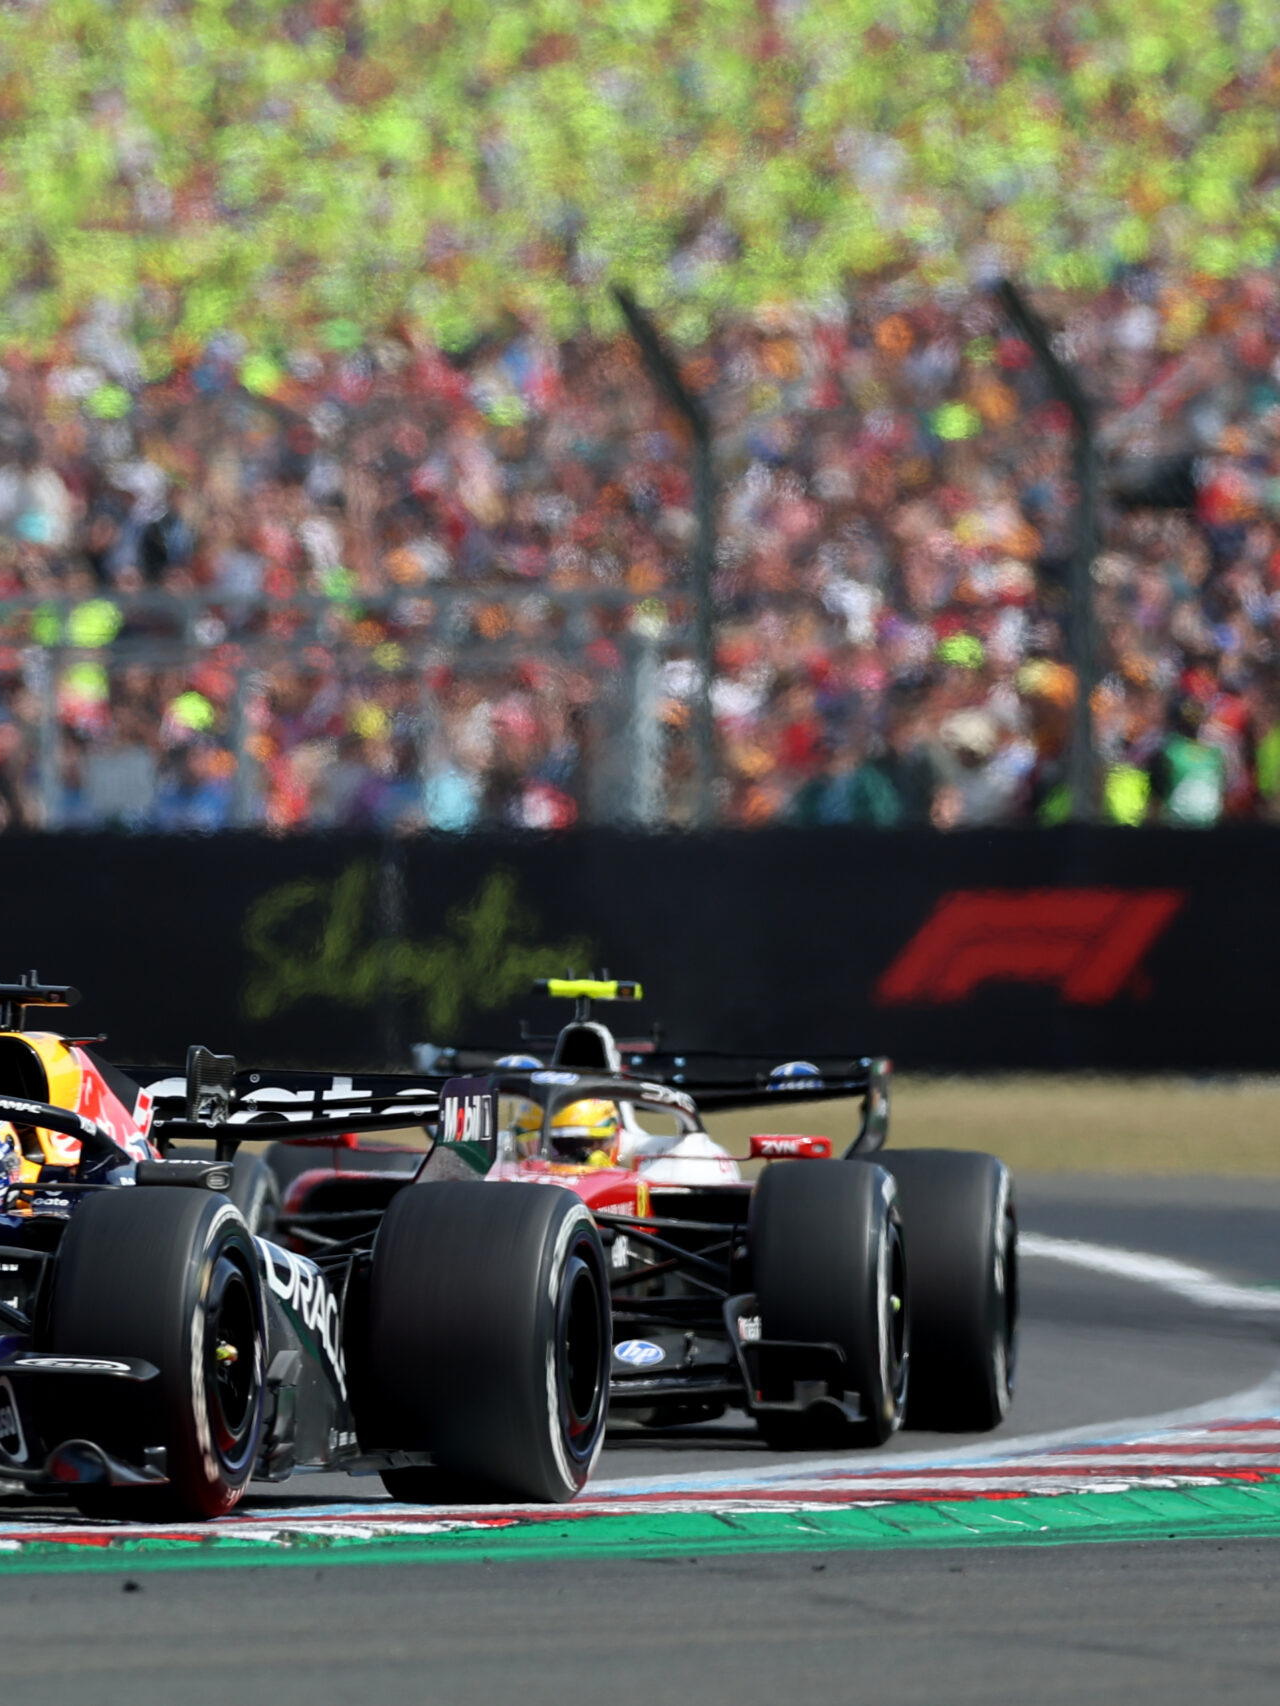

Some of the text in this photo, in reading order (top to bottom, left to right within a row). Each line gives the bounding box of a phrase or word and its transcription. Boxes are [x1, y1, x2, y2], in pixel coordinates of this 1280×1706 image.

[875, 888, 1184, 1004] F1
[444, 1094, 481, 1142] Mobil
[619, 1342, 658, 1365] hp
